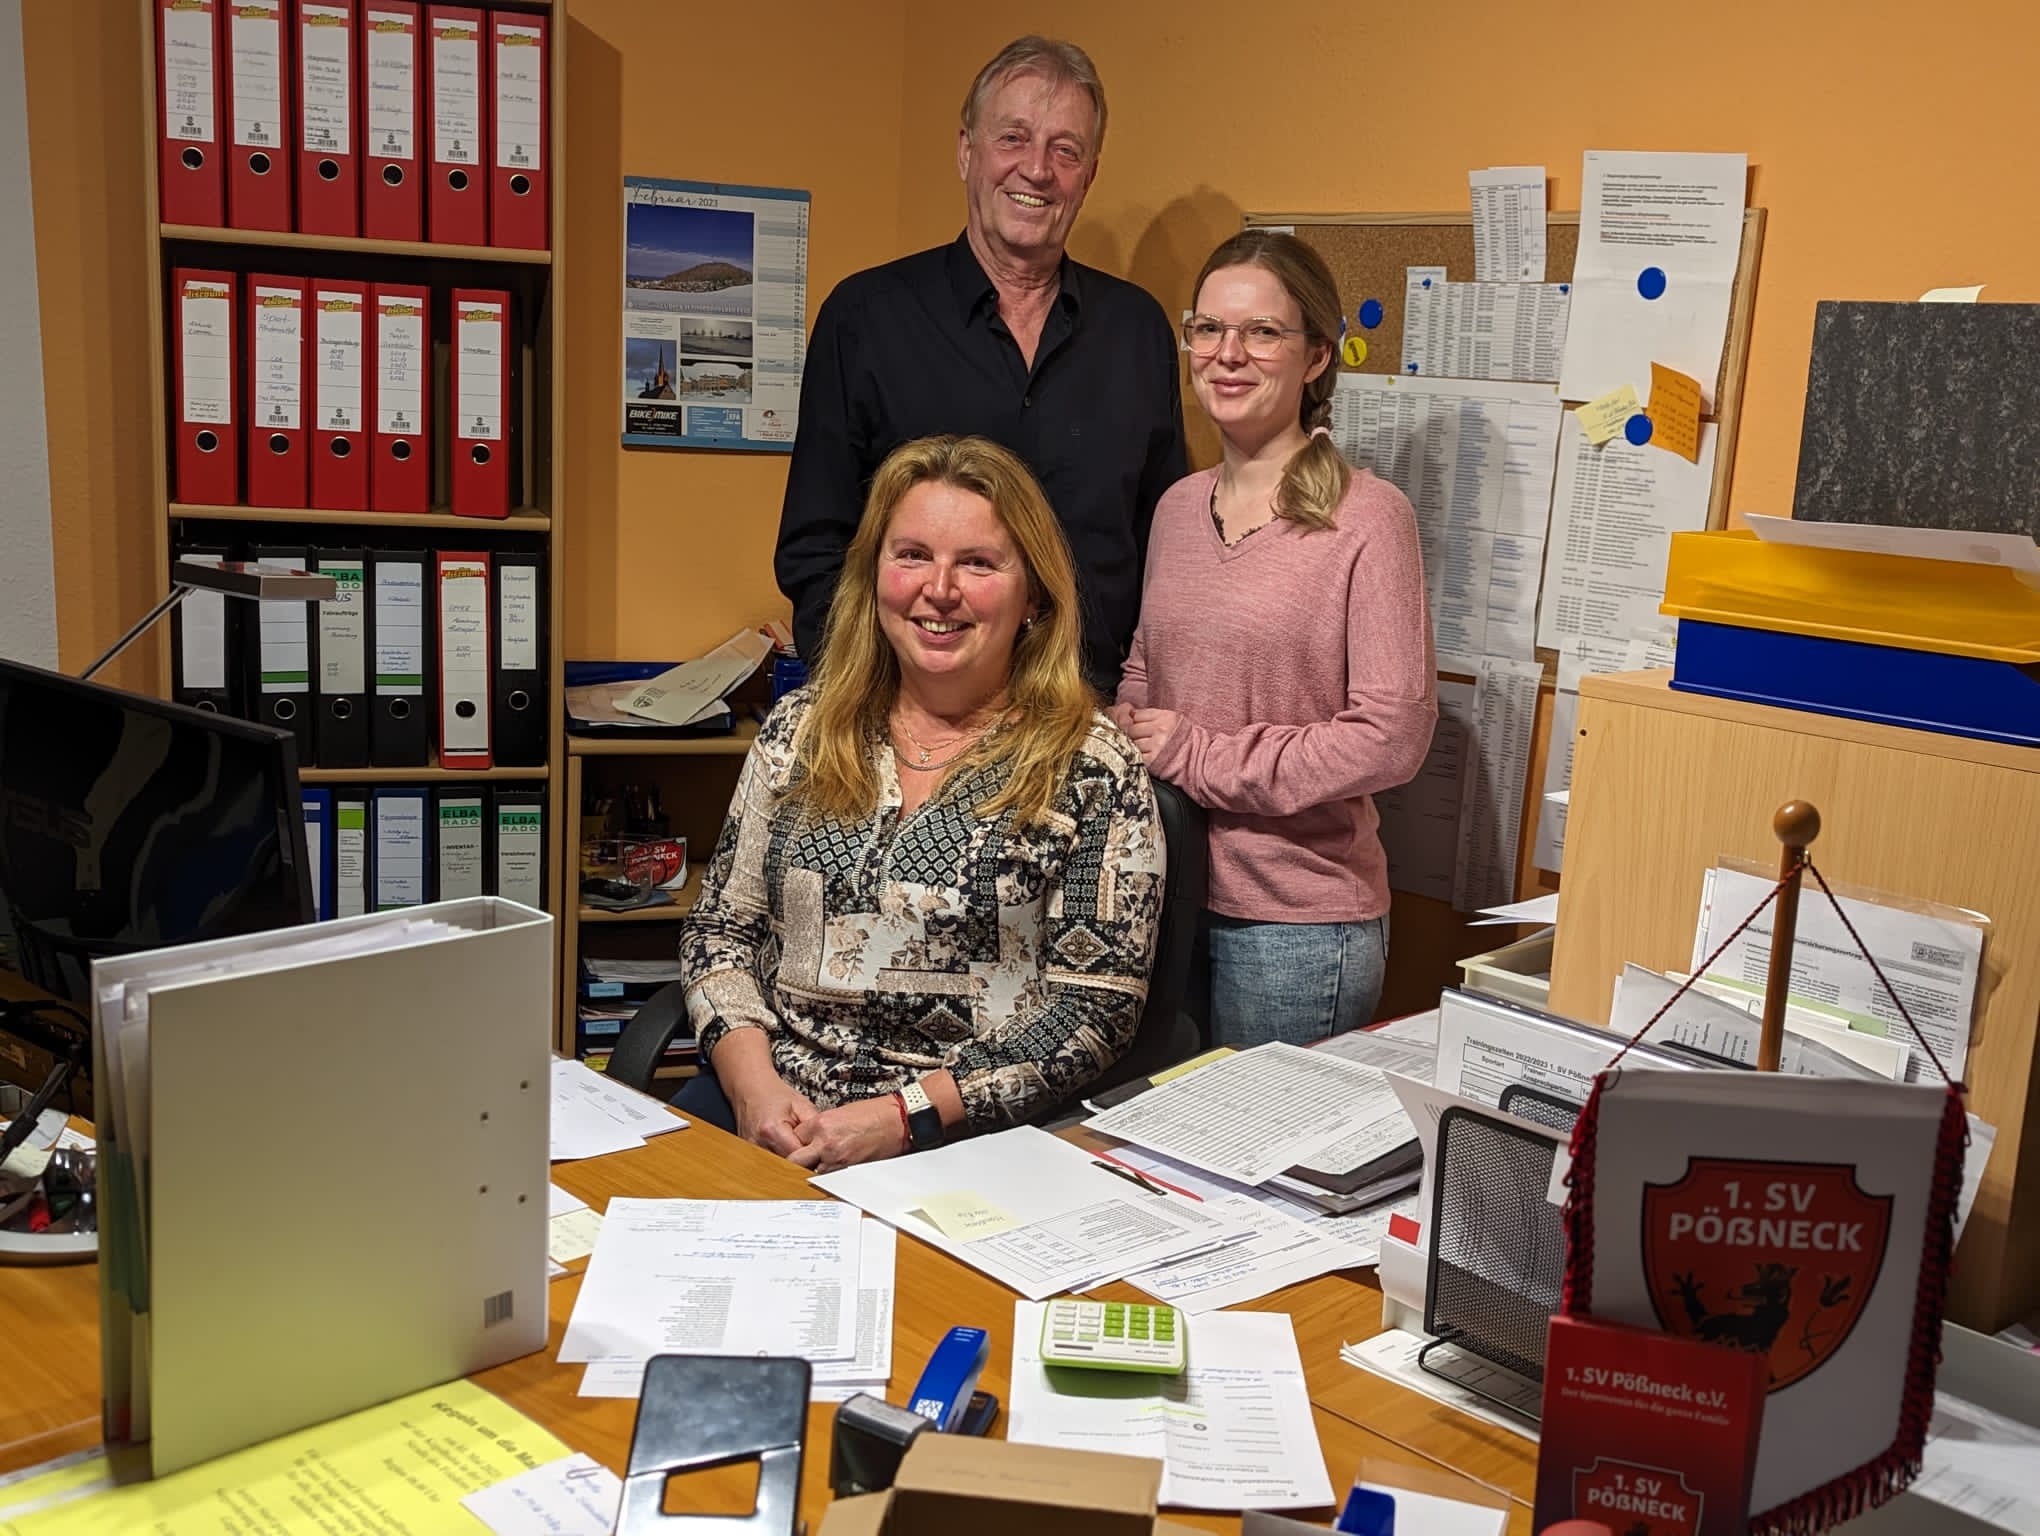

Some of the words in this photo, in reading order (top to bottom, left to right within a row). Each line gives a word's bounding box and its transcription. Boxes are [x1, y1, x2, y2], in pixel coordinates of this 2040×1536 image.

[699, 198, 718, 207] 2023
[443, 809, 479, 818] ELBA
[502, 816, 537, 824] ELBA
[1466, 1036, 1514, 1058] Trainingszeiten
[1515, 1052, 1548, 1068] 2022/2023
[1557, 1065, 1567, 1076] SV
[1481, 1055, 1505, 1068] Sportart
[1722, 1182, 1752, 1212] 1.
[1764, 1183, 1818, 1214] SV
[1566, 1367, 1579, 1382] 1.
[1582, 1367, 1609, 1386] SV
[1612, 1372, 1694, 1403] Pößneck
[1695, 1391, 1729, 1409] e.V.
[1561, 1387, 1577, 1397] Der
[1580, 1392, 1633, 1408] Sportverein
[1634, 1399, 1650, 1410] für
[1650, 1401, 1665, 1413] die
[1666, 1407, 1693, 1418] ganze
[1695, 1410, 1730, 1426] Familie
[432, 1402, 479, 1427] Kegeln
[476, 1425, 499, 1440] um
[496, 1438, 518, 1454] die
[1615, 1475, 1630, 1491] 1.
[1635, 1478, 1662, 1496] SV
